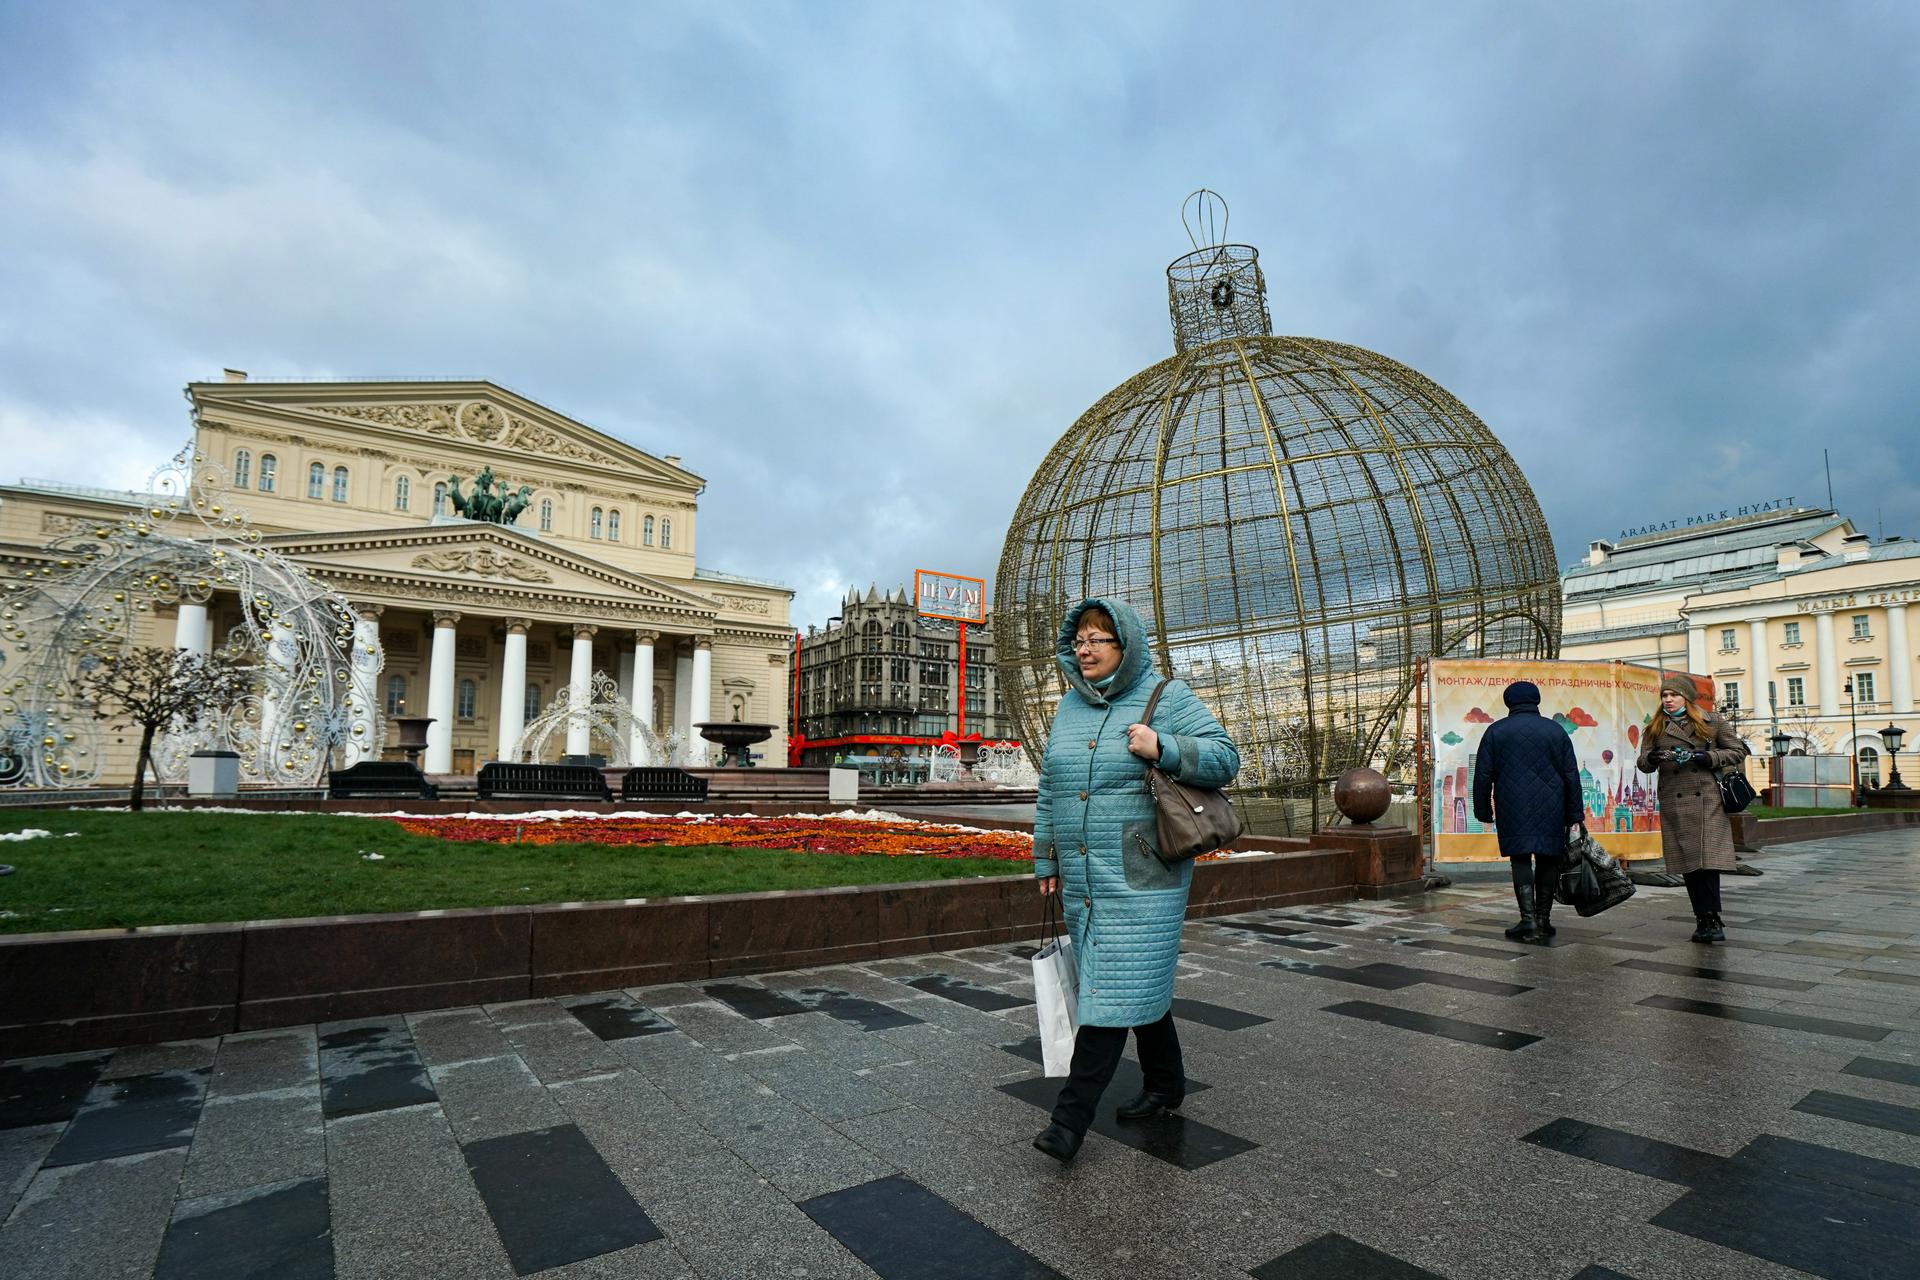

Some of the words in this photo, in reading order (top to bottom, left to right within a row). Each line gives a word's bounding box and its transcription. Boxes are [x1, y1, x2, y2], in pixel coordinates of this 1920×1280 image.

[1620, 520, 1678, 538] ARARAT
[1687, 510, 1729, 526] PARK
[1738, 497, 1796, 516] HYATT
[1797, 593, 1857, 612] МАЛЫЙ
[1549, 678, 1620, 689] ПРАЗДНИЧНЫХ
